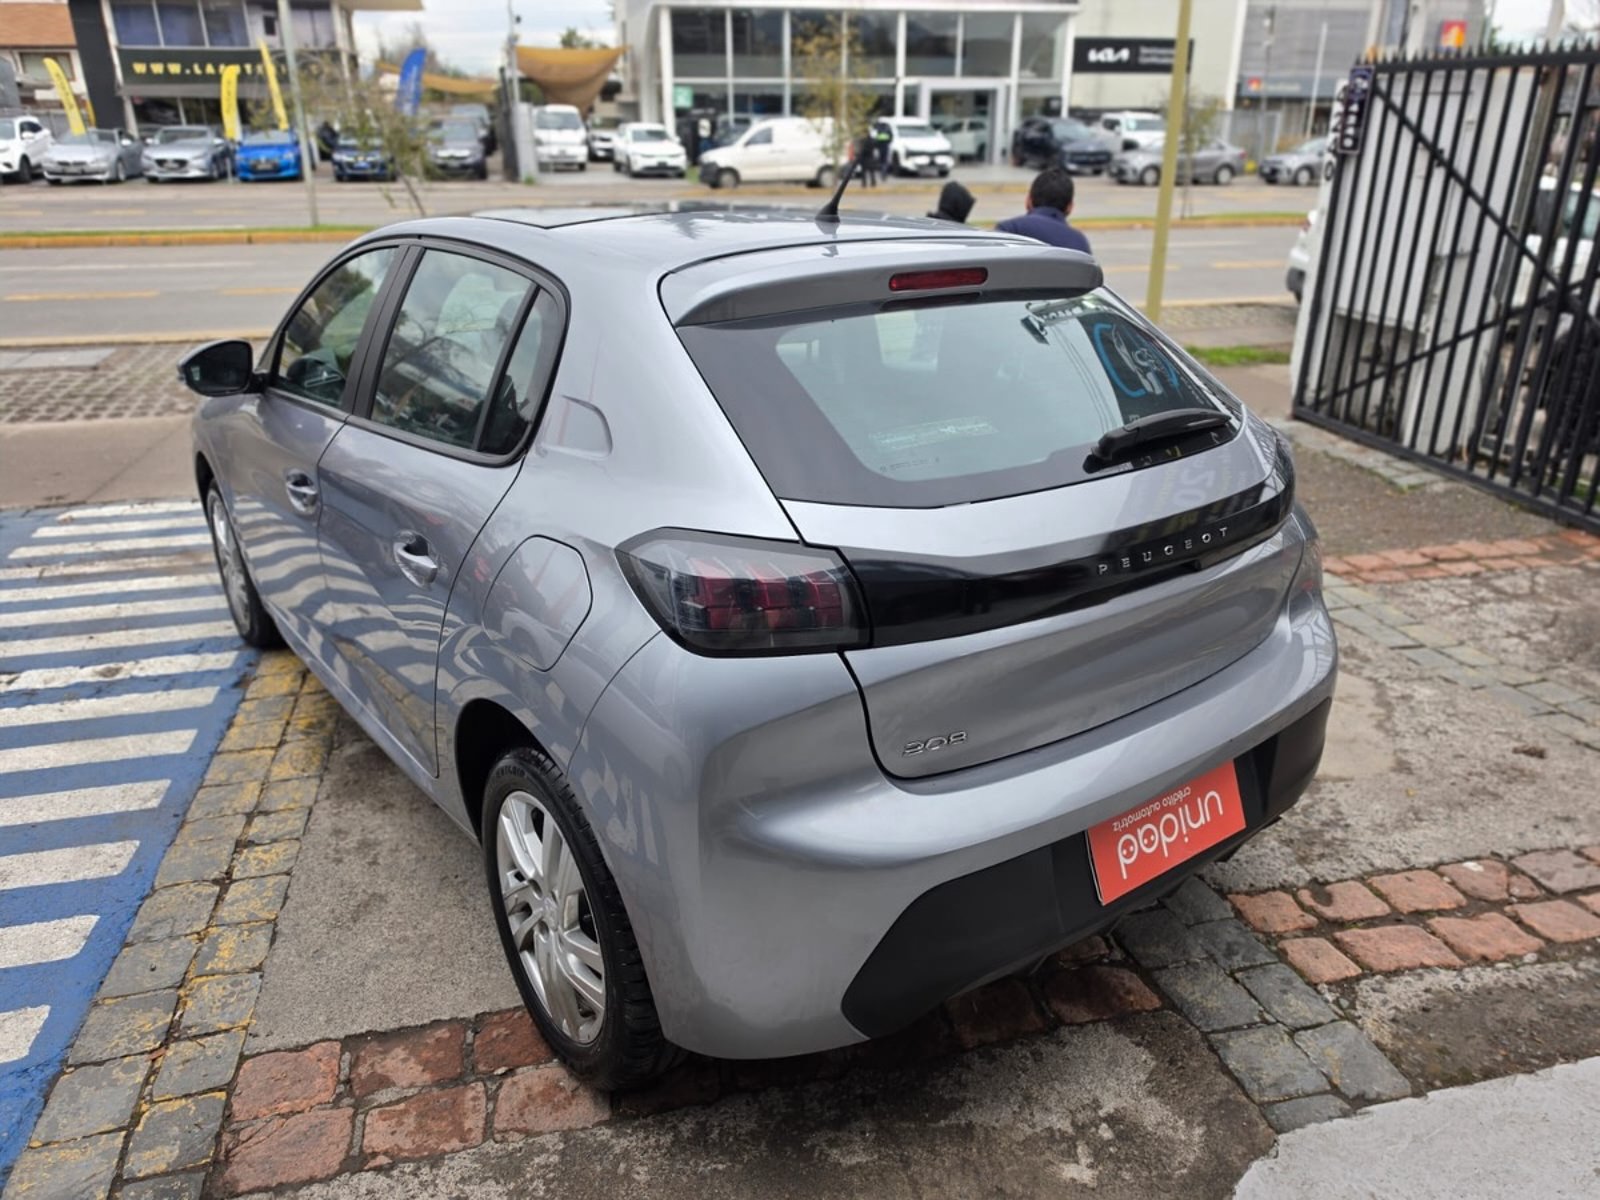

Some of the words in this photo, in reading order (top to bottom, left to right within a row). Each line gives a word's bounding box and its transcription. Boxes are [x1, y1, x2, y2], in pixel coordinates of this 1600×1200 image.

[1098, 527, 1228, 575] PEUGEOT
[903, 731, 968, 757] 208
[1112, 801, 1161, 832] automotriz
[1117, 790, 1224, 880] unidad
